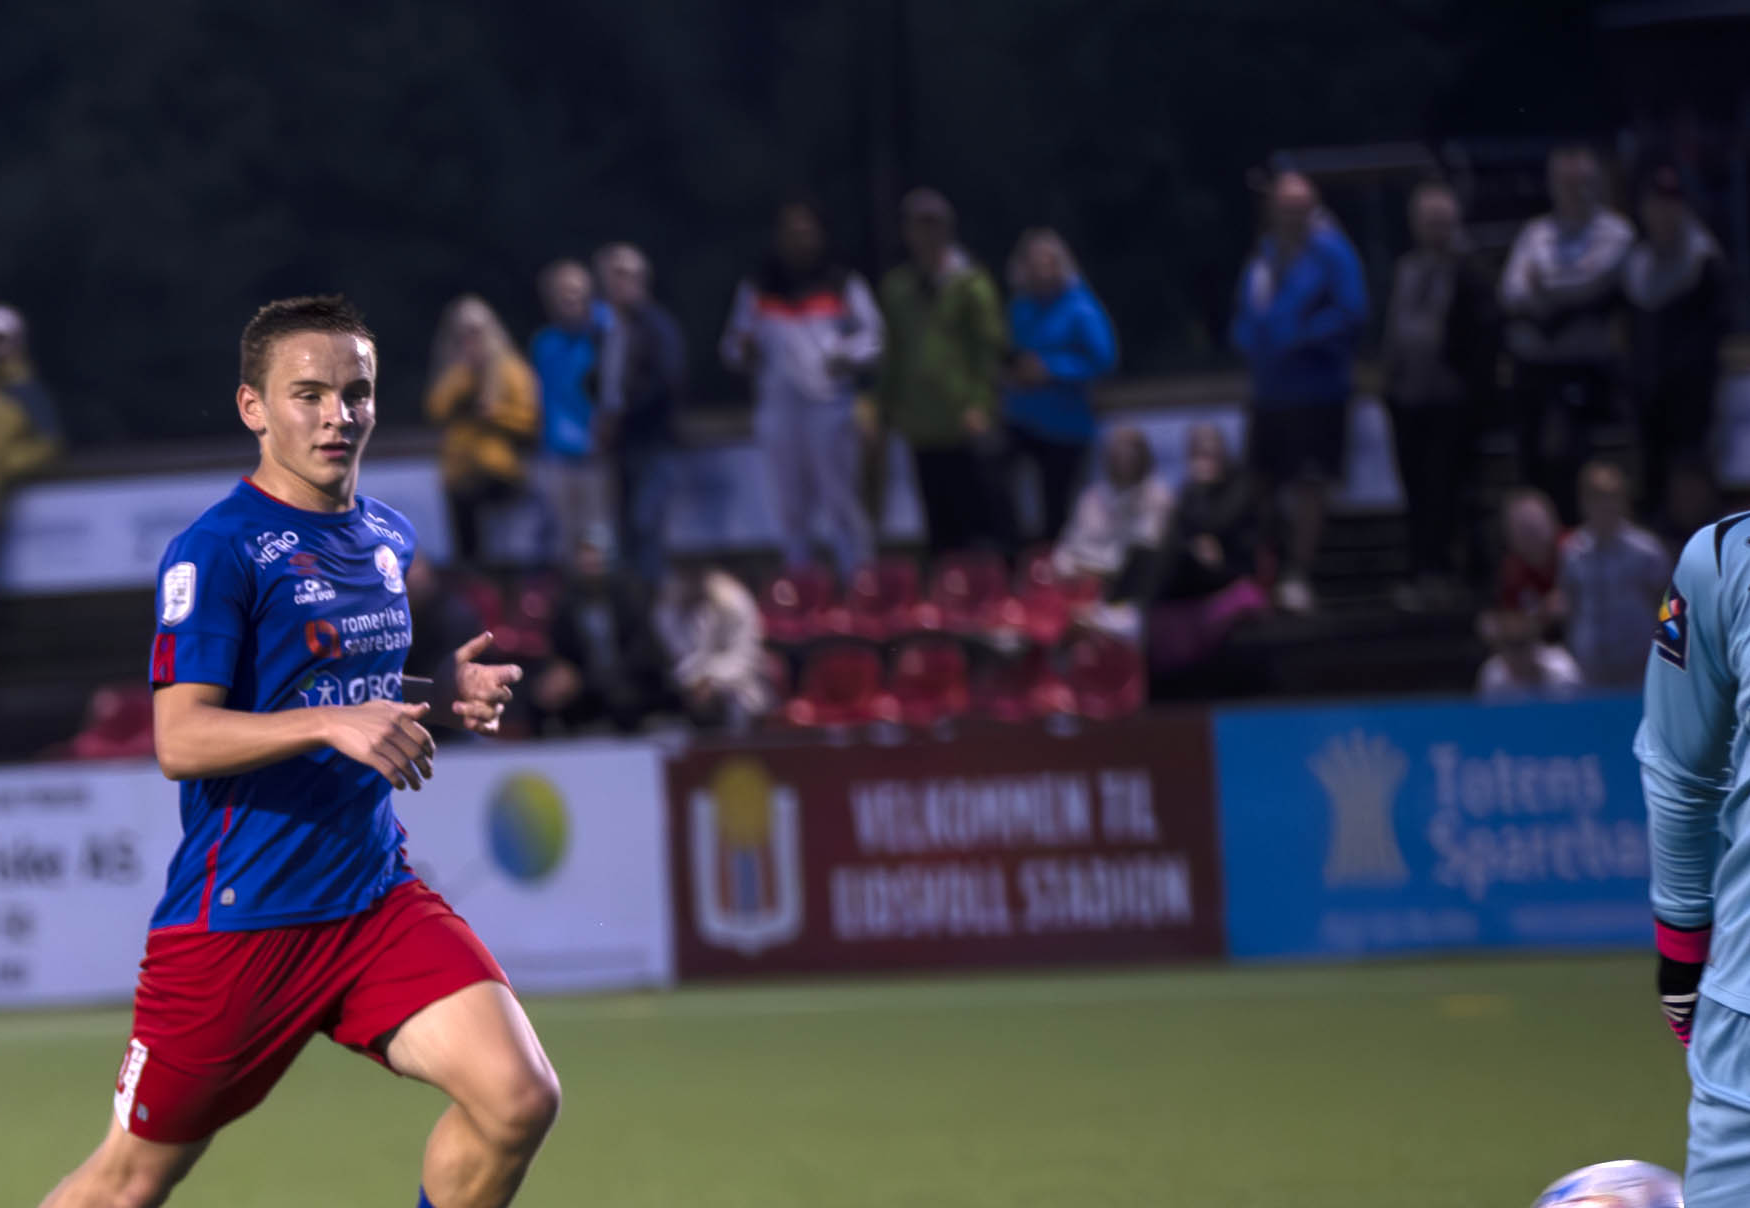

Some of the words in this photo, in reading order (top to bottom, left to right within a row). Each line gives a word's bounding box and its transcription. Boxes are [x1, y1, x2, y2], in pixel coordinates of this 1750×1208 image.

[341, 608, 406, 633] romerike
[344, 630, 412, 656] spareban
[348, 672, 404, 705] OBO
[1429, 742, 1604, 817] Totens
